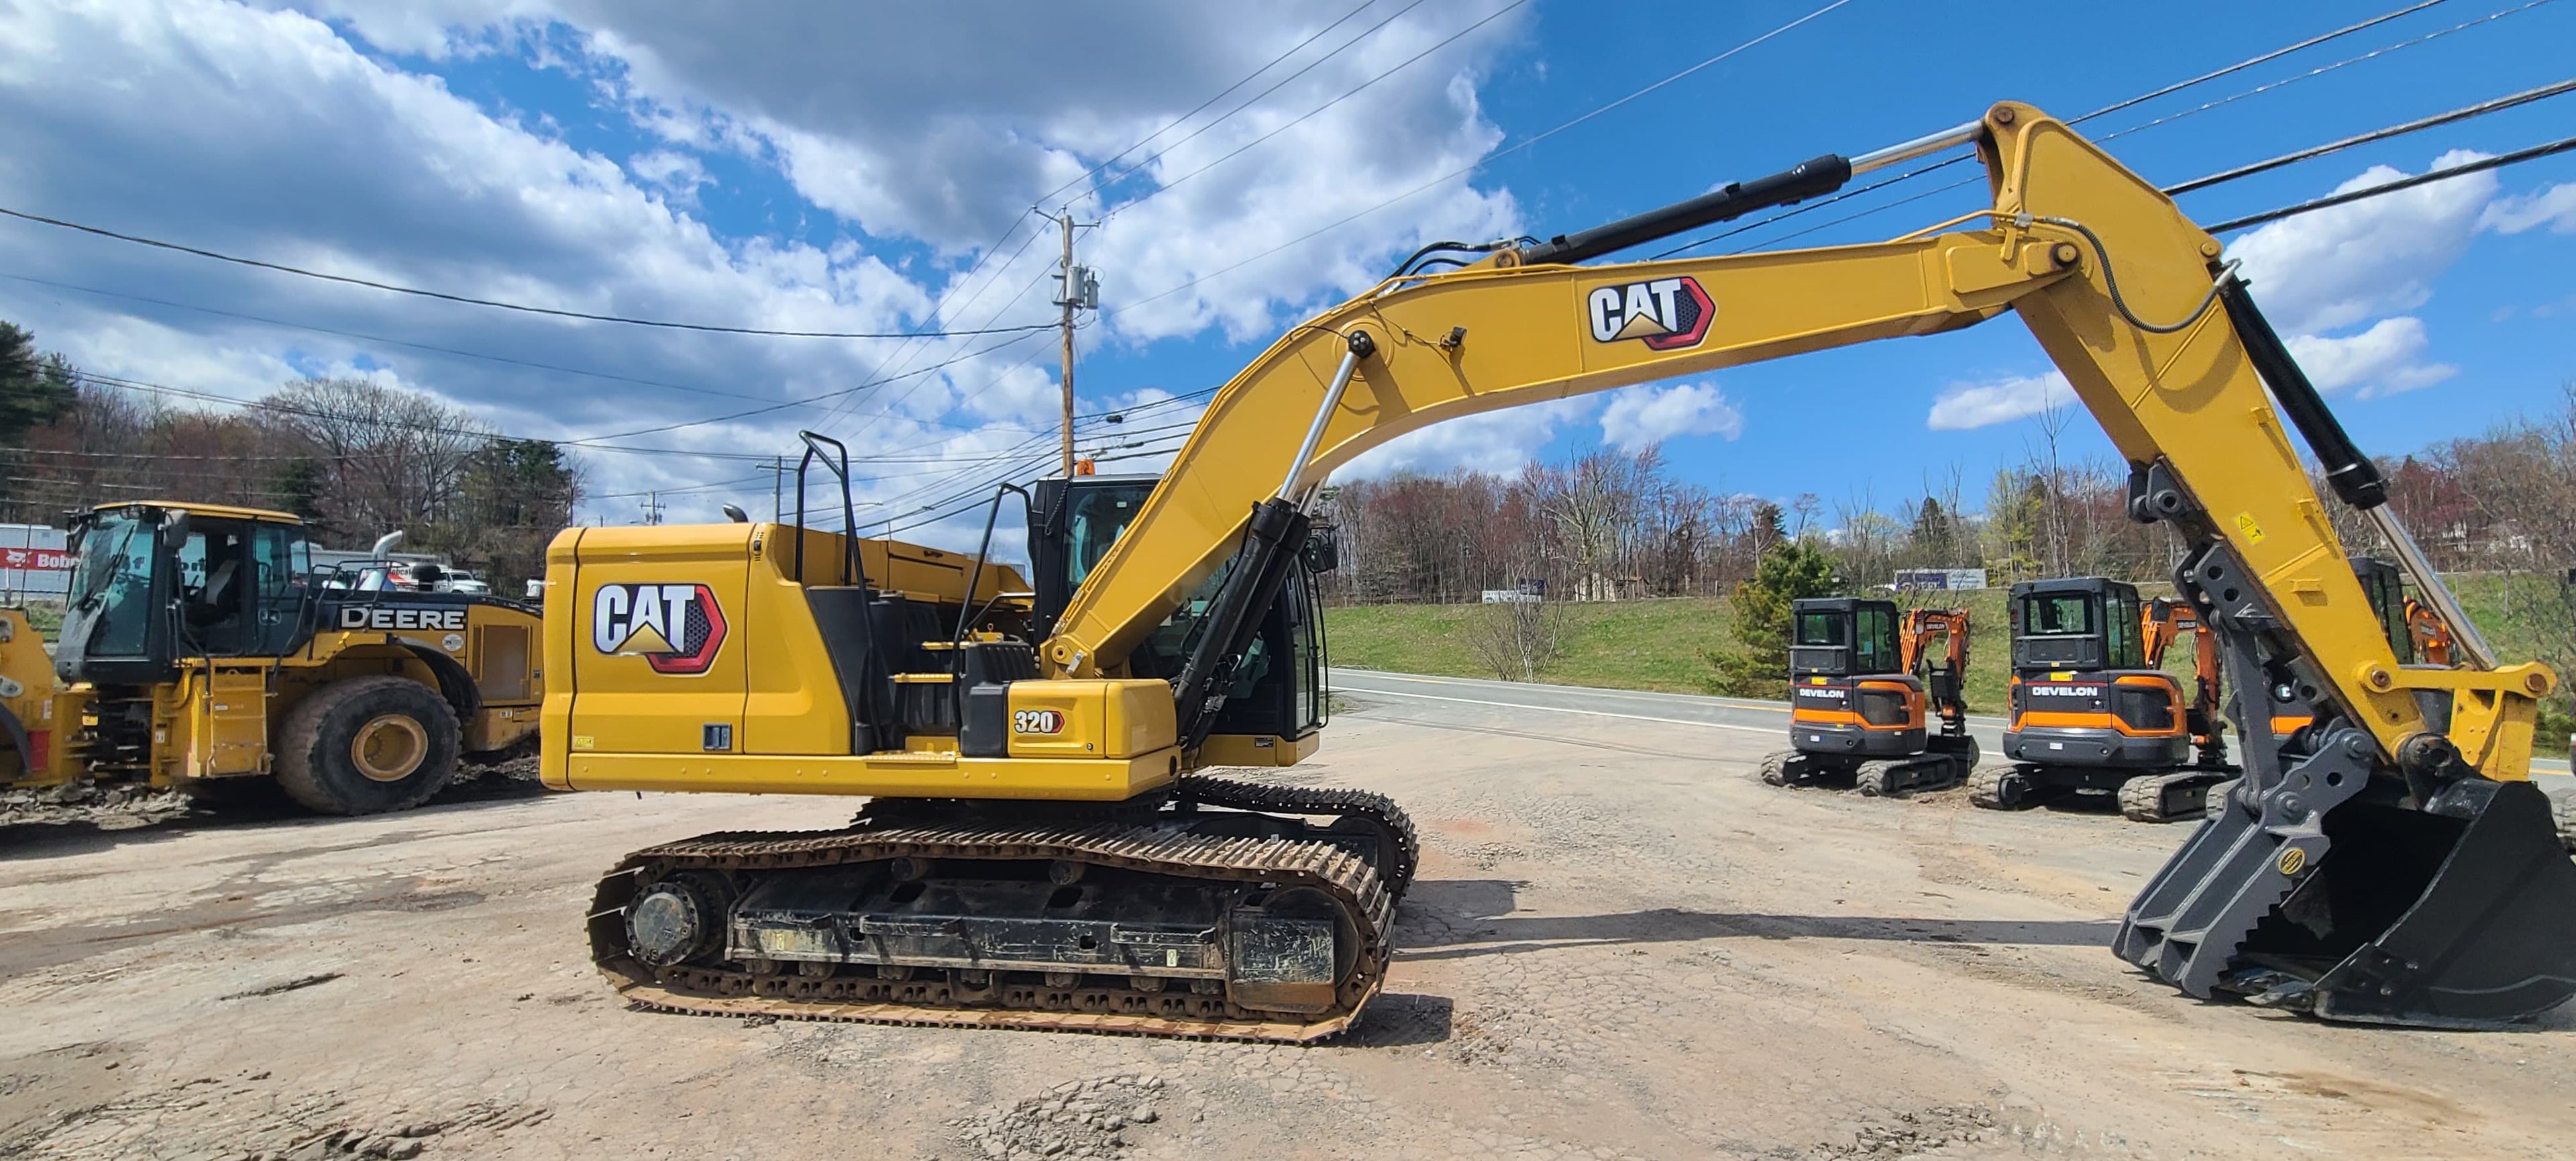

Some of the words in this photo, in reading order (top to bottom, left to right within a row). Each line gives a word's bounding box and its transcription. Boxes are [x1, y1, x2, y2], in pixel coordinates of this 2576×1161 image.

[1589, 279, 1681, 342] CAT
[341, 607, 464, 629] DEERE
[596, 585, 695, 652] CAT
[1799, 689, 1844, 698] DEVELON
[2032, 687, 2098, 696] DEVELON
[1014, 711, 1053, 732] 320
